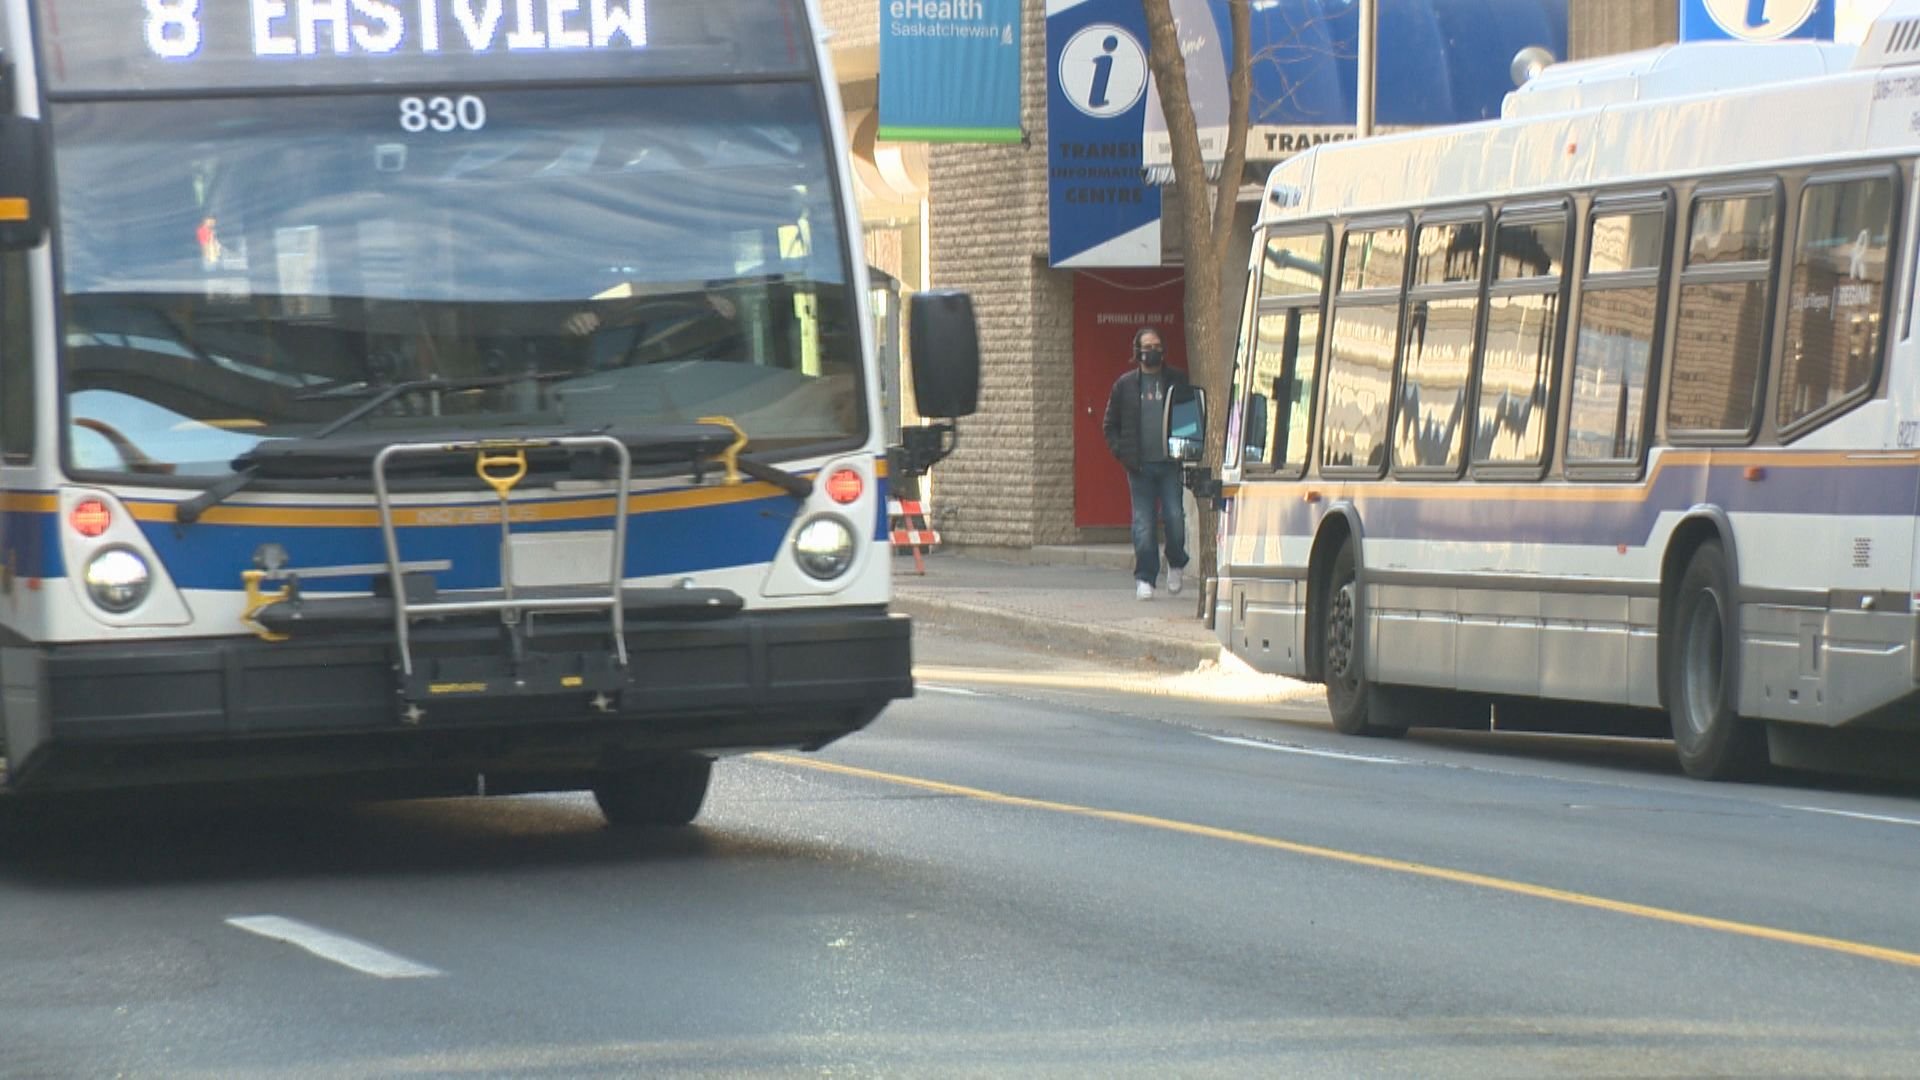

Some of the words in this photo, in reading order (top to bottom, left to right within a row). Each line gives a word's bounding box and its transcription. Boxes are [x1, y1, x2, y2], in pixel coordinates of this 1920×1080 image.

[890, 0, 982, 19] eHealth
[145, 0, 202, 58] 8
[252, 0, 648, 56] EASTVIEW
[891, 21, 998, 37] Saskatchewan
[400, 95, 486, 132] 830
[1060, 143, 1140, 158] TRANSI
[1052, 167, 1146, 177] INFORMATIO
[1065, 187, 1142, 204] CENTRE
[1097, 313, 1144, 325] SPRINKLER
